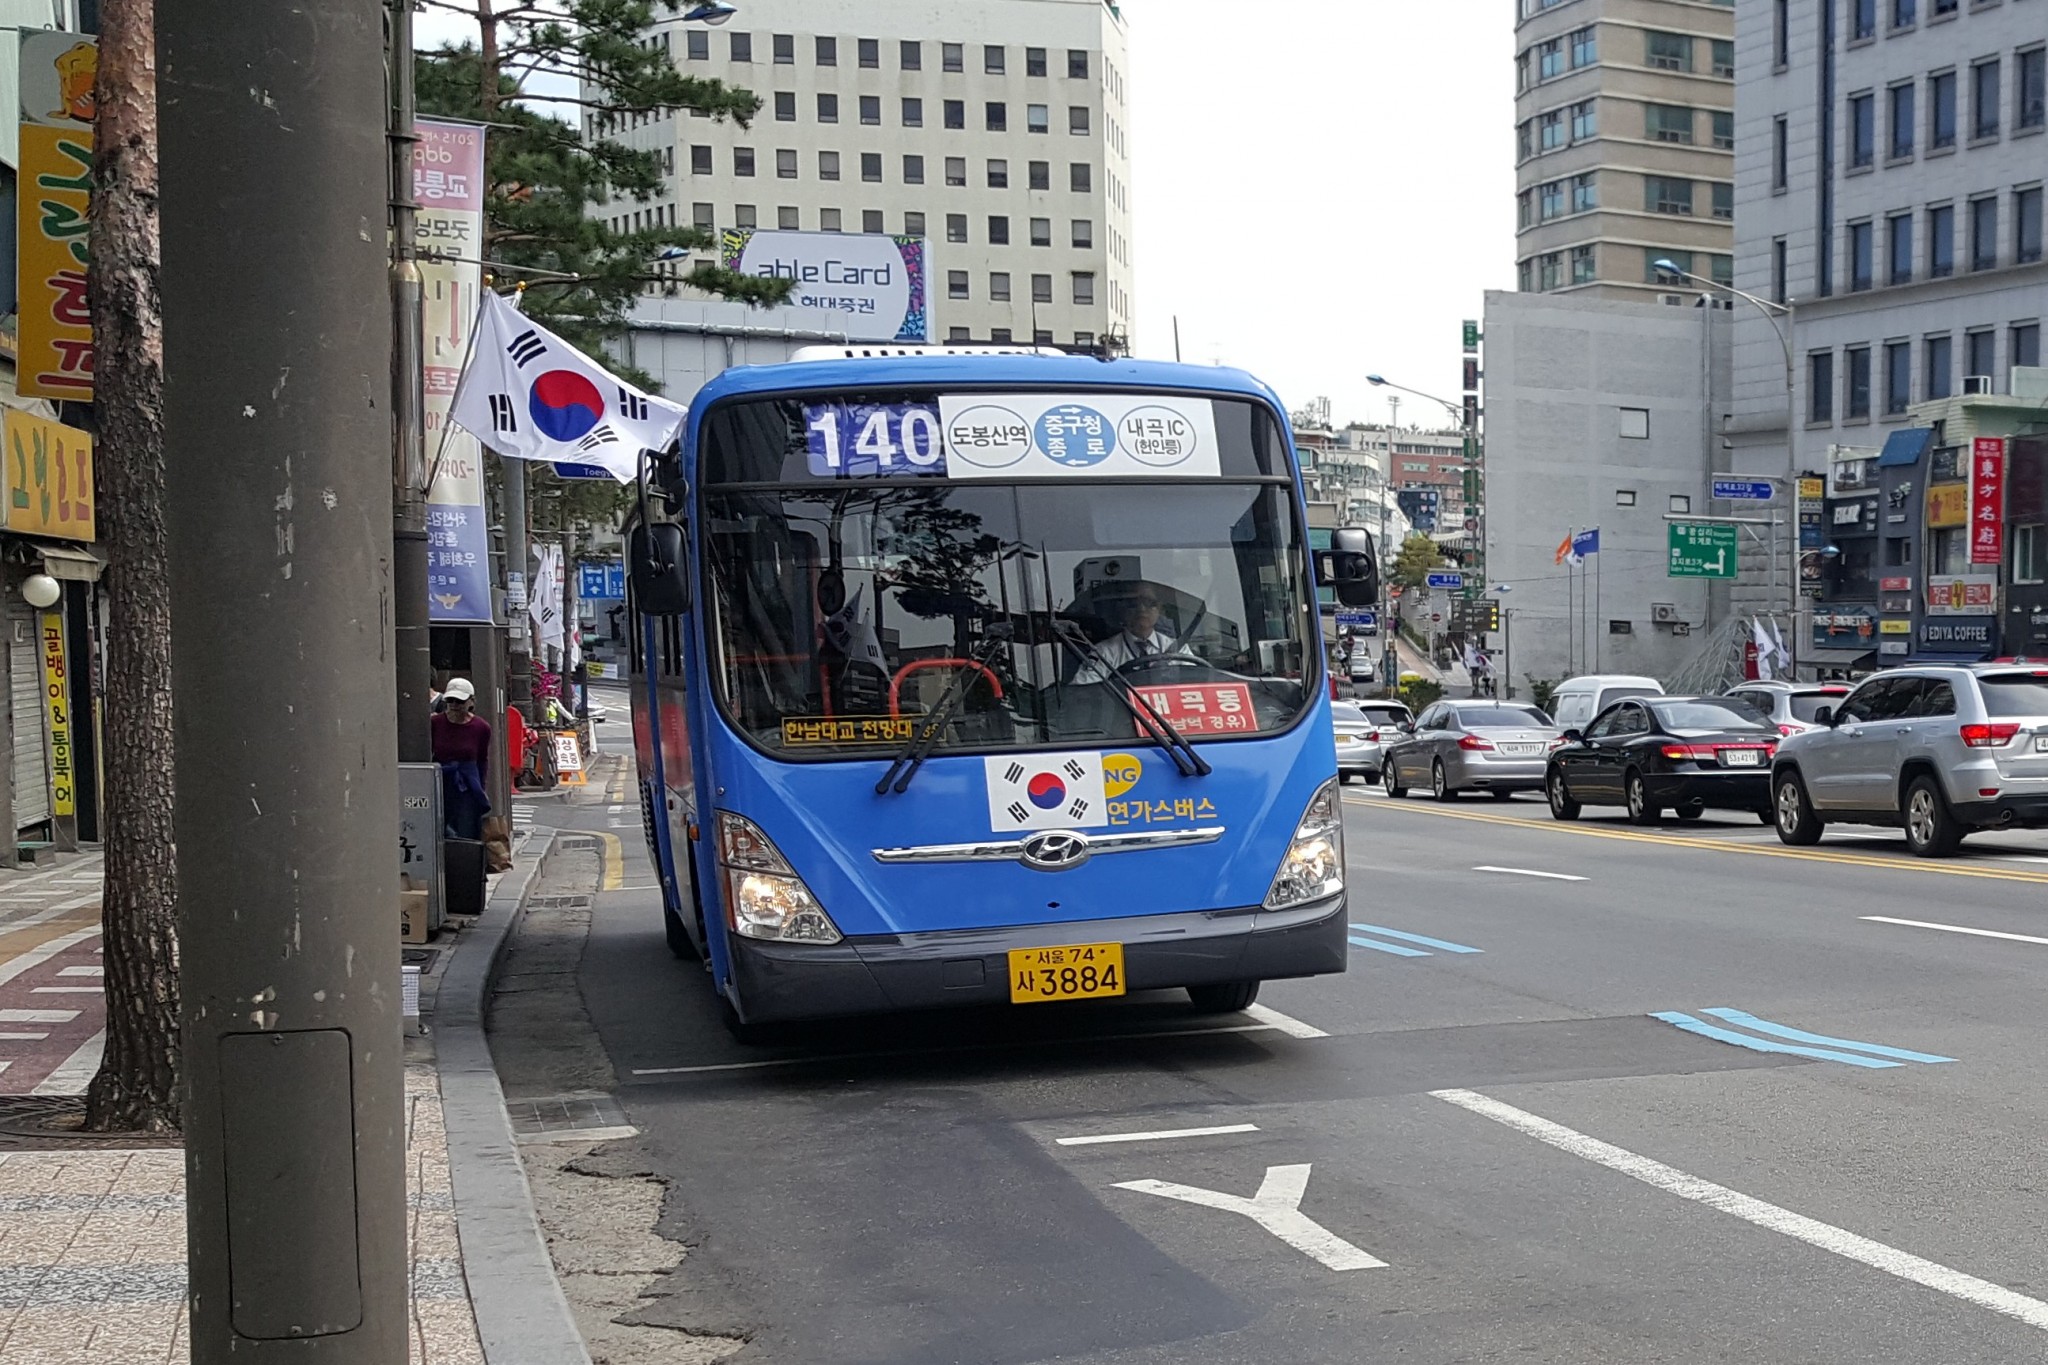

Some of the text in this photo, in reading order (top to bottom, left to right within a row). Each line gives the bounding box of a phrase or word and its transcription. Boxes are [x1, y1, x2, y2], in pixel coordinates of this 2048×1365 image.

[758, 258, 891, 286] able Card
[953, 424, 1028, 447] 도봉산역
[1044, 414, 1102, 436] 중구청
[809, 408, 942, 468] 140
[1134, 438, 1182, 456] (헌인릉)
[1928, 626, 1987, 641] EDIYA COFFEE
[785, 720, 856, 742] 한남대교
[862, 719, 913, 739] 전망대
[1107, 797, 1218, 825] 연가스버스
[1037, 947, 1095, 964] 서울 74
[1039, 964, 1119, 996] 3884
